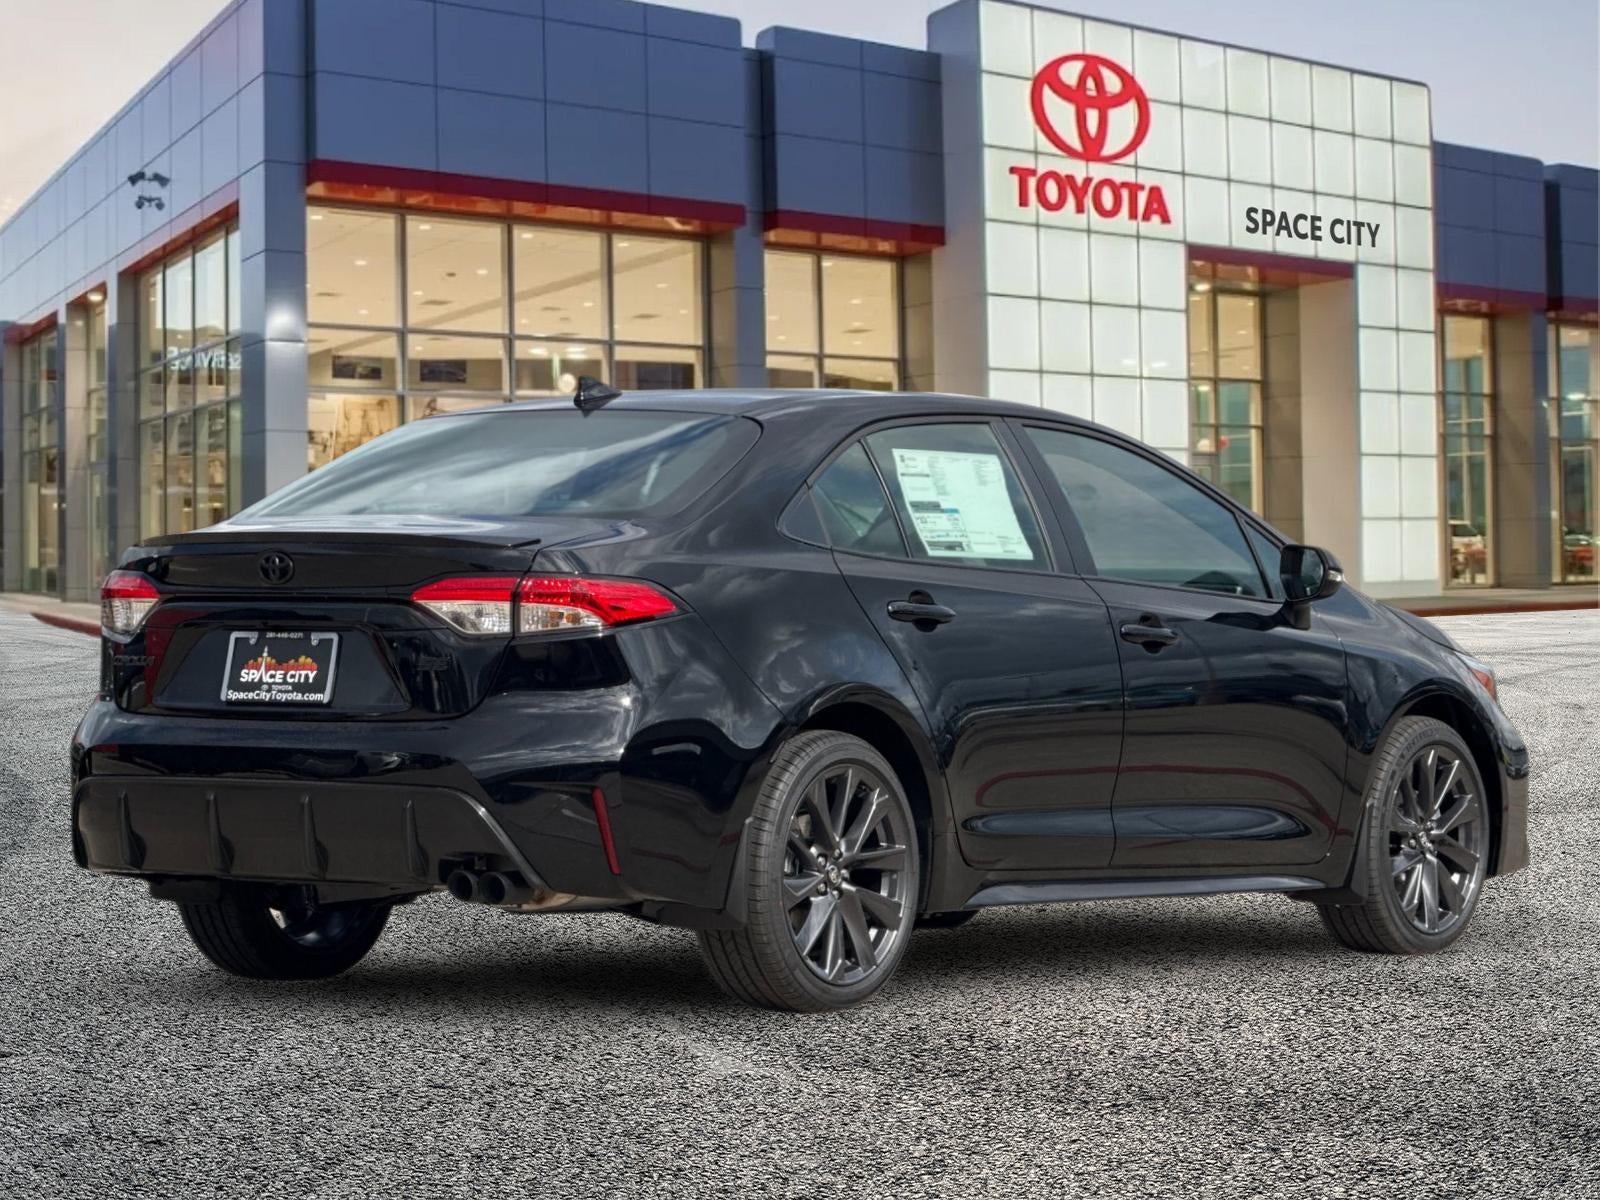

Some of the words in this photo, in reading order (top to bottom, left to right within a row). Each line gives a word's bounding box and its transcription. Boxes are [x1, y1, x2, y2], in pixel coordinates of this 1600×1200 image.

[1009, 166, 1171, 224] TOYOTA
[1246, 206, 1323, 241] SPACE
[1329, 217, 1381, 248] CITY
[240, 668, 284, 682] SPACE
[286, 670, 317, 683] CITY
[227, 689, 324, 701] SpaceCityToyota.com
